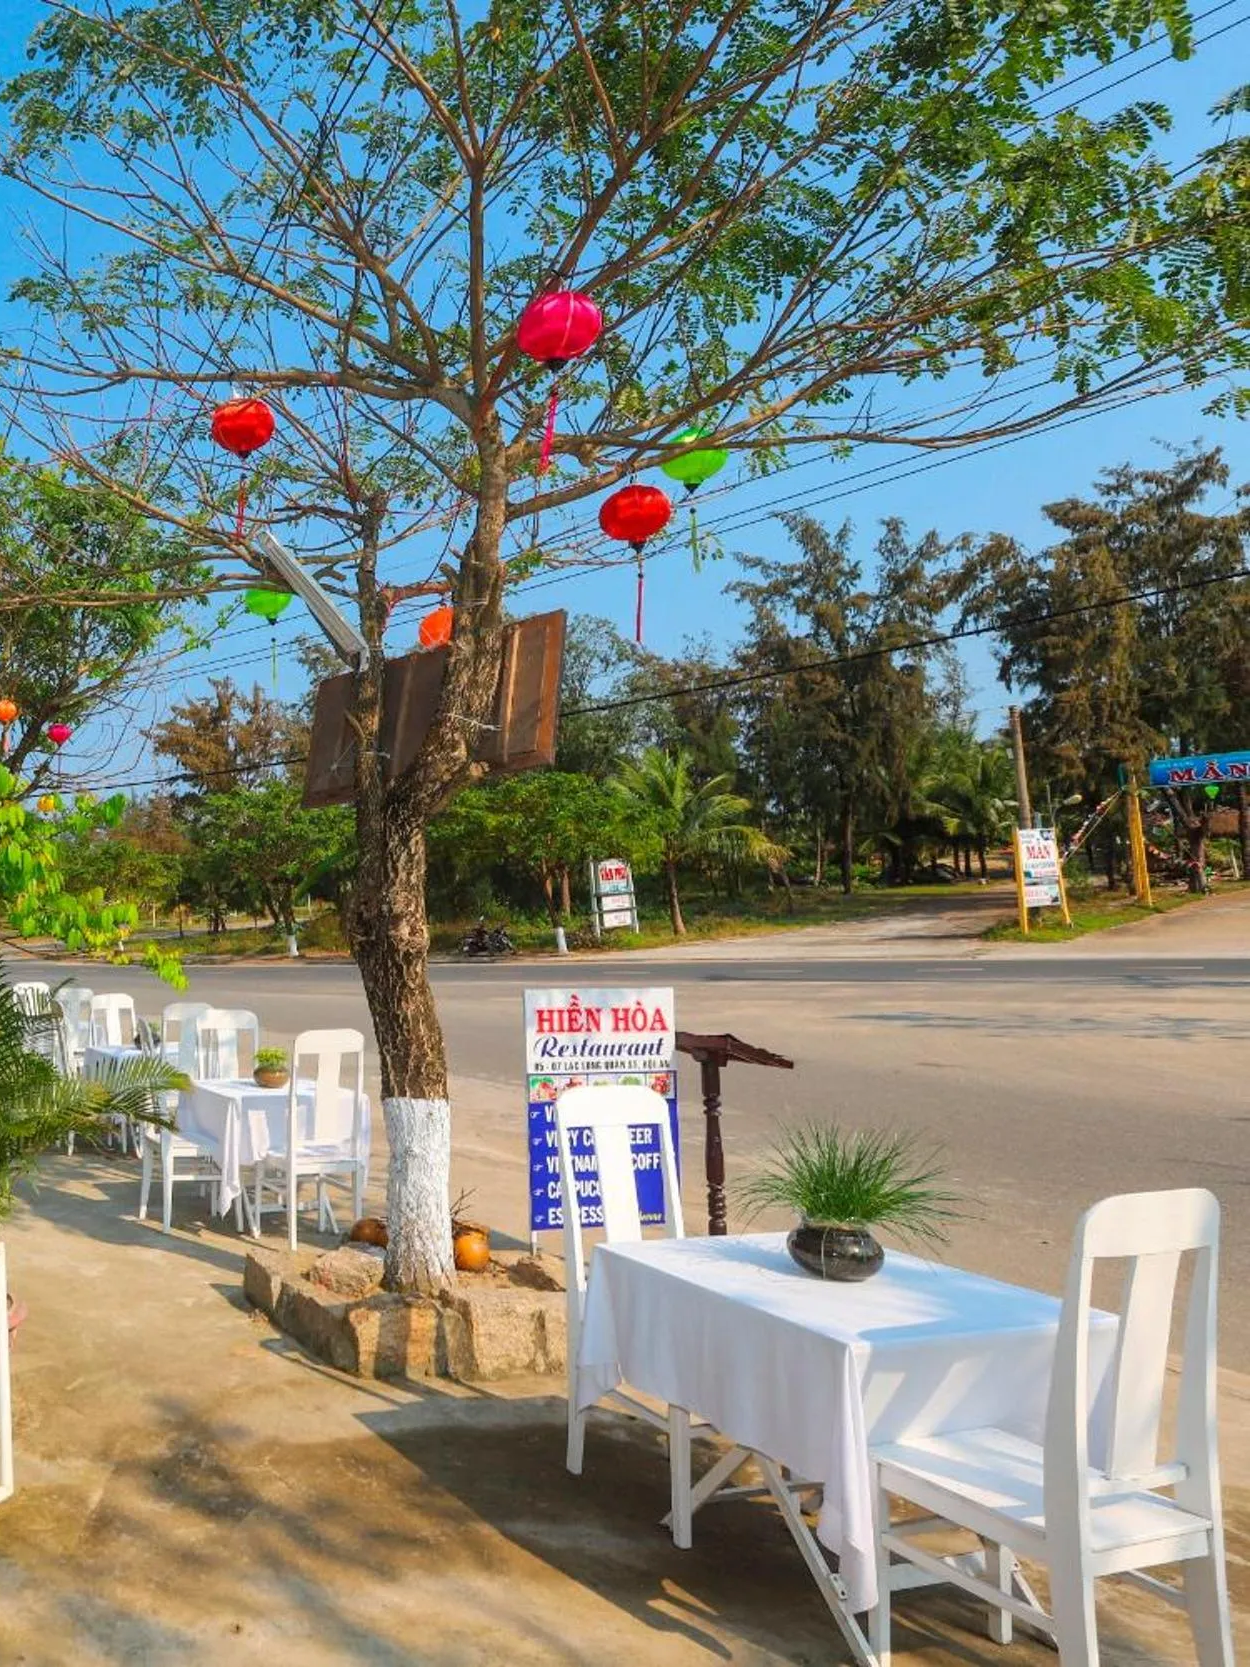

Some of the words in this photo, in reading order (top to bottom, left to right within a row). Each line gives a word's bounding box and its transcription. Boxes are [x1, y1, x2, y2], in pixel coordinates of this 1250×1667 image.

[535, 994, 603, 1034] HIỀN
[611, 1002, 669, 1032] HÒA
[534, 1036, 665, 1058] Restaurant
[629, 1128, 653, 1145] EER
